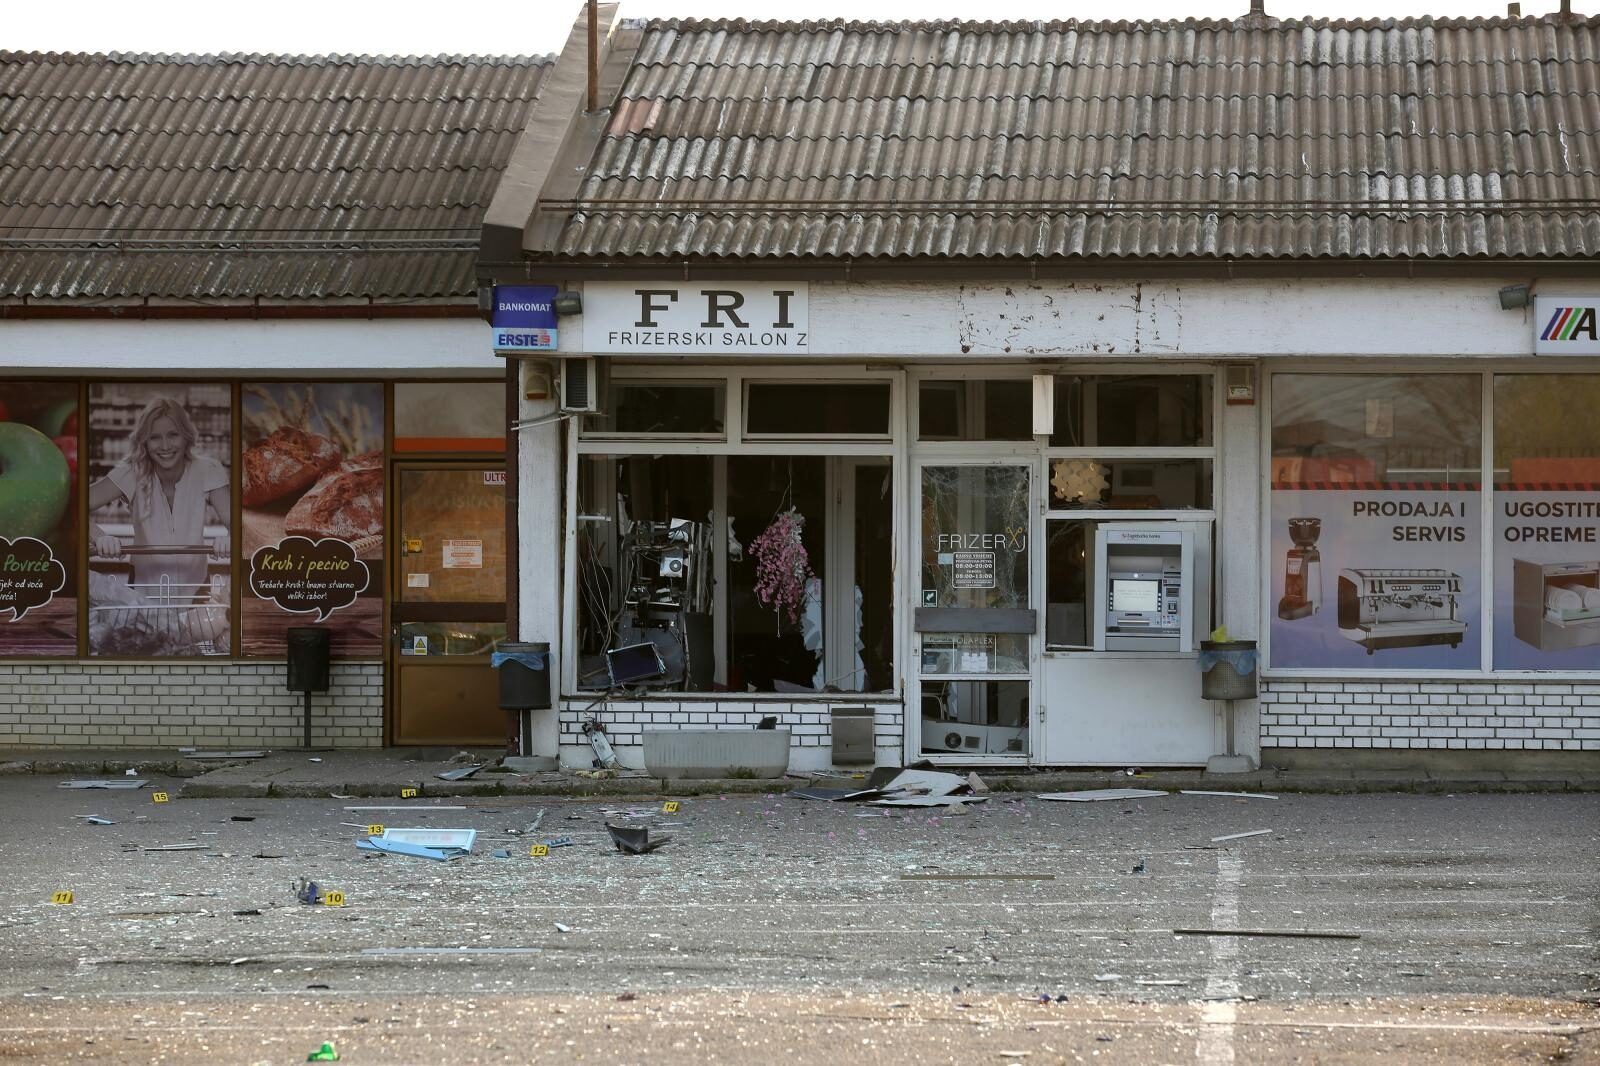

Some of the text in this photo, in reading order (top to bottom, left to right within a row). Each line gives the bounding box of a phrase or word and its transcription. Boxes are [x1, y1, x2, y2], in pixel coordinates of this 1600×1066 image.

[499, 303, 552, 312] BANKOMAT
[635, 290, 795, 328] FRI
[498, 334, 539, 346] ERSTE
[608, 331, 808, 346] FRIZERSKI SALON Z
[1353, 501, 1465, 517] PRODAJA I
[1392, 525, 1466, 542] SERVIS
[1504, 526, 1597, 543] OPREME
[3, 553, 50, 572] Povrće
[261, 554, 350, 579] Kruh i pecivo
[0, 578, 44, 591] jek od voća
[258, 580, 284, 589] Trebate
[306, 580, 327, 589] Imamo
[329, 580, 355, 589] stvarno
[287, 591, 328, 600] veliki izbor!
[328, 894, 342, 903] 10
